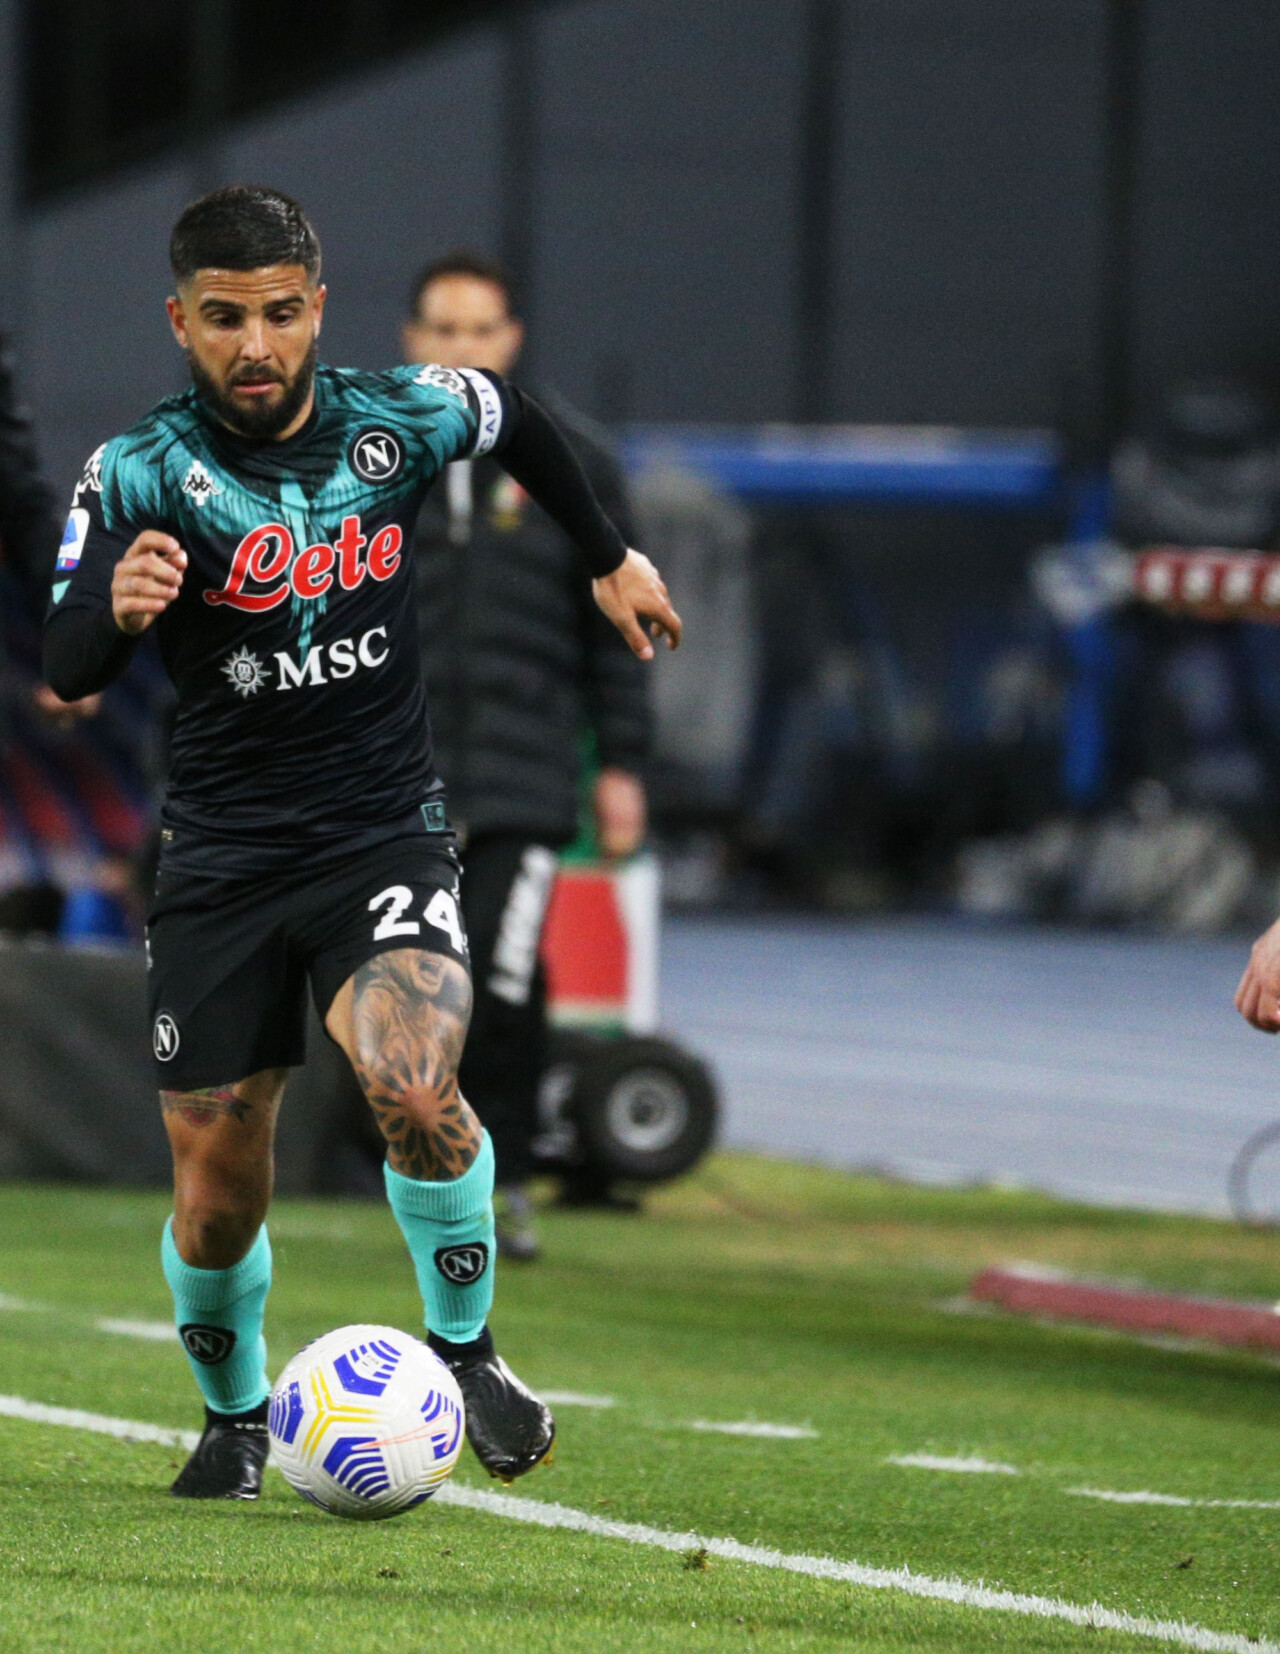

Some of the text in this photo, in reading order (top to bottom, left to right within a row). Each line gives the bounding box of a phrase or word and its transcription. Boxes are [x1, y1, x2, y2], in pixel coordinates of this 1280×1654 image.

[360, 439, 390, 471] N
[203, 514, 403, 613] Lete
[273, 625, 390, 691] MSC
[367, 884, 464, 955] 24
[155, 1023, 172, 1052] N
[450, 1252, 475, 1275] N
